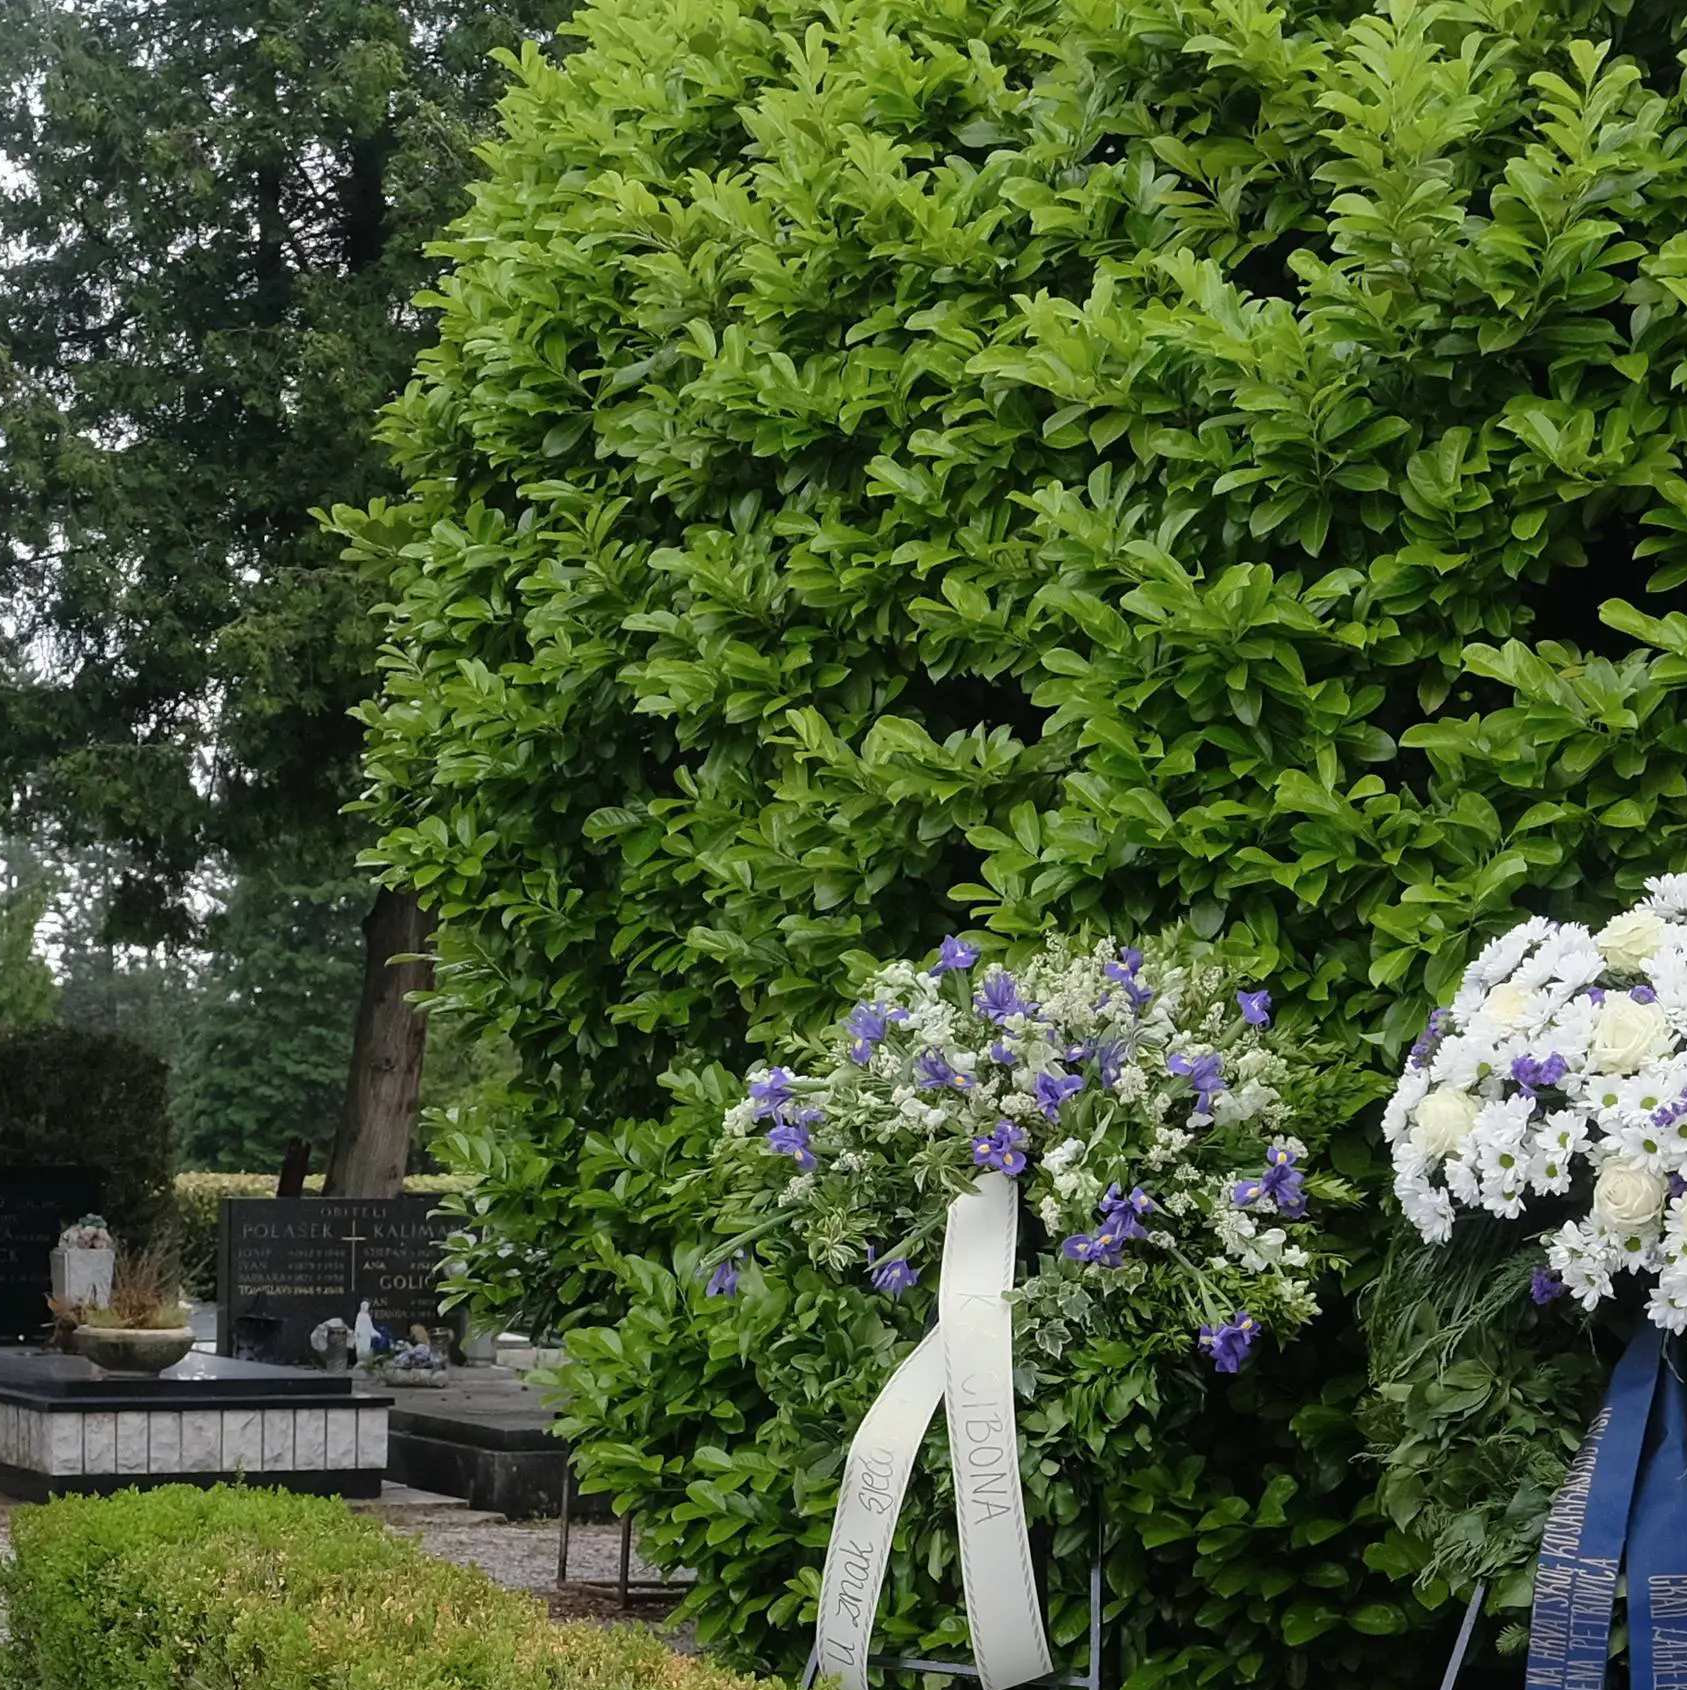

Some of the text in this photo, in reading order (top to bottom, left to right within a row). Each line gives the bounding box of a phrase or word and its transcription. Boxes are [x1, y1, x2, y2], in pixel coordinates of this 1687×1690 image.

[320, 1206, 387, 1219] OBITELJ
[959, 1369, 1012, 1527] CIBONA
[833, 1538, 874, 1628] znak
[1526, 1665, 1565, 1688] NA
